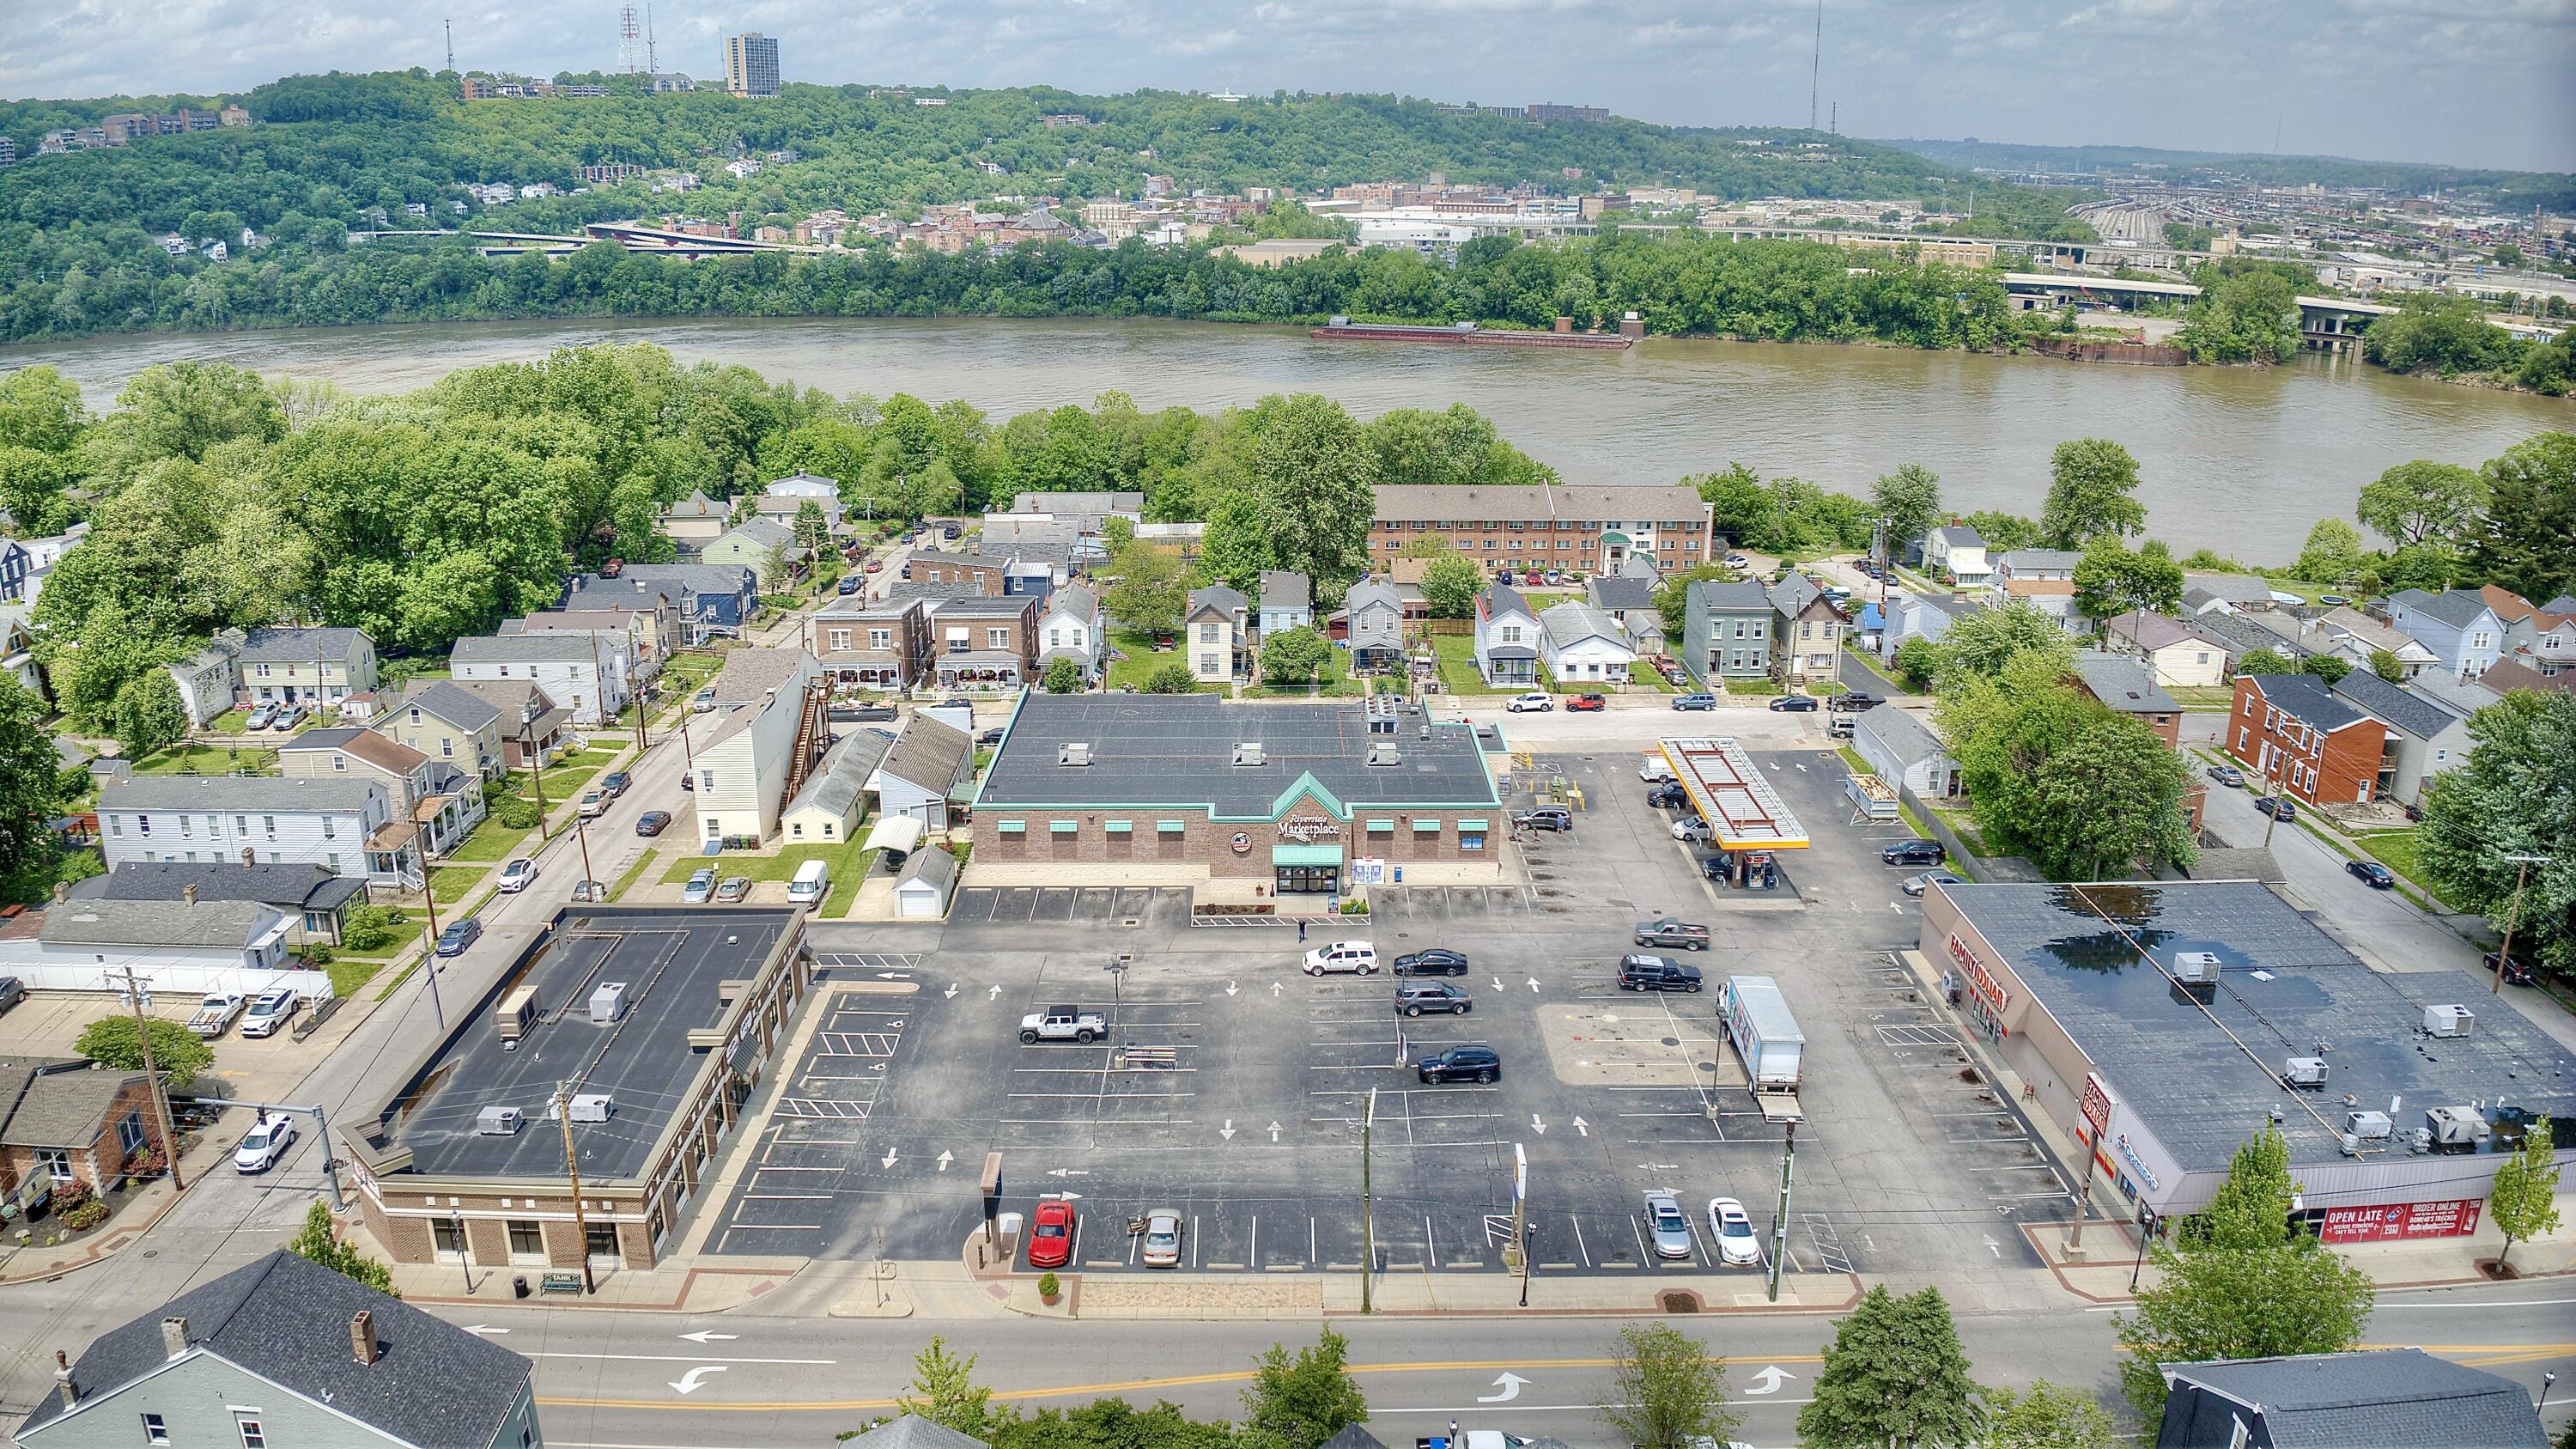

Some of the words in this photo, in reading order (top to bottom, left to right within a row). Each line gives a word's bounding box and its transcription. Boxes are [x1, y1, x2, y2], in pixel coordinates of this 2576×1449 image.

[1278, 822, 1340, 838] Marketplace
[1291, 814, 1327, 823] Riverside
[1950, 931, 1978, 977] FAMILY
[1975, 964, 2007, 1013] DOLLAR
[2086, 1079, 2110, 1118] FAMILY
[2082, 1095, 2106, 1135] DOLLAR
[2124, 1143, 2159, 1190] Domino's
[2329, 1211, 2356, 1223] OPEN
[2357, 1210, 2383, 1221] LATE
[2412, 1203, 2436, 1212] ORDER
[2436, 1202, 2461, 1211] ONLINE
